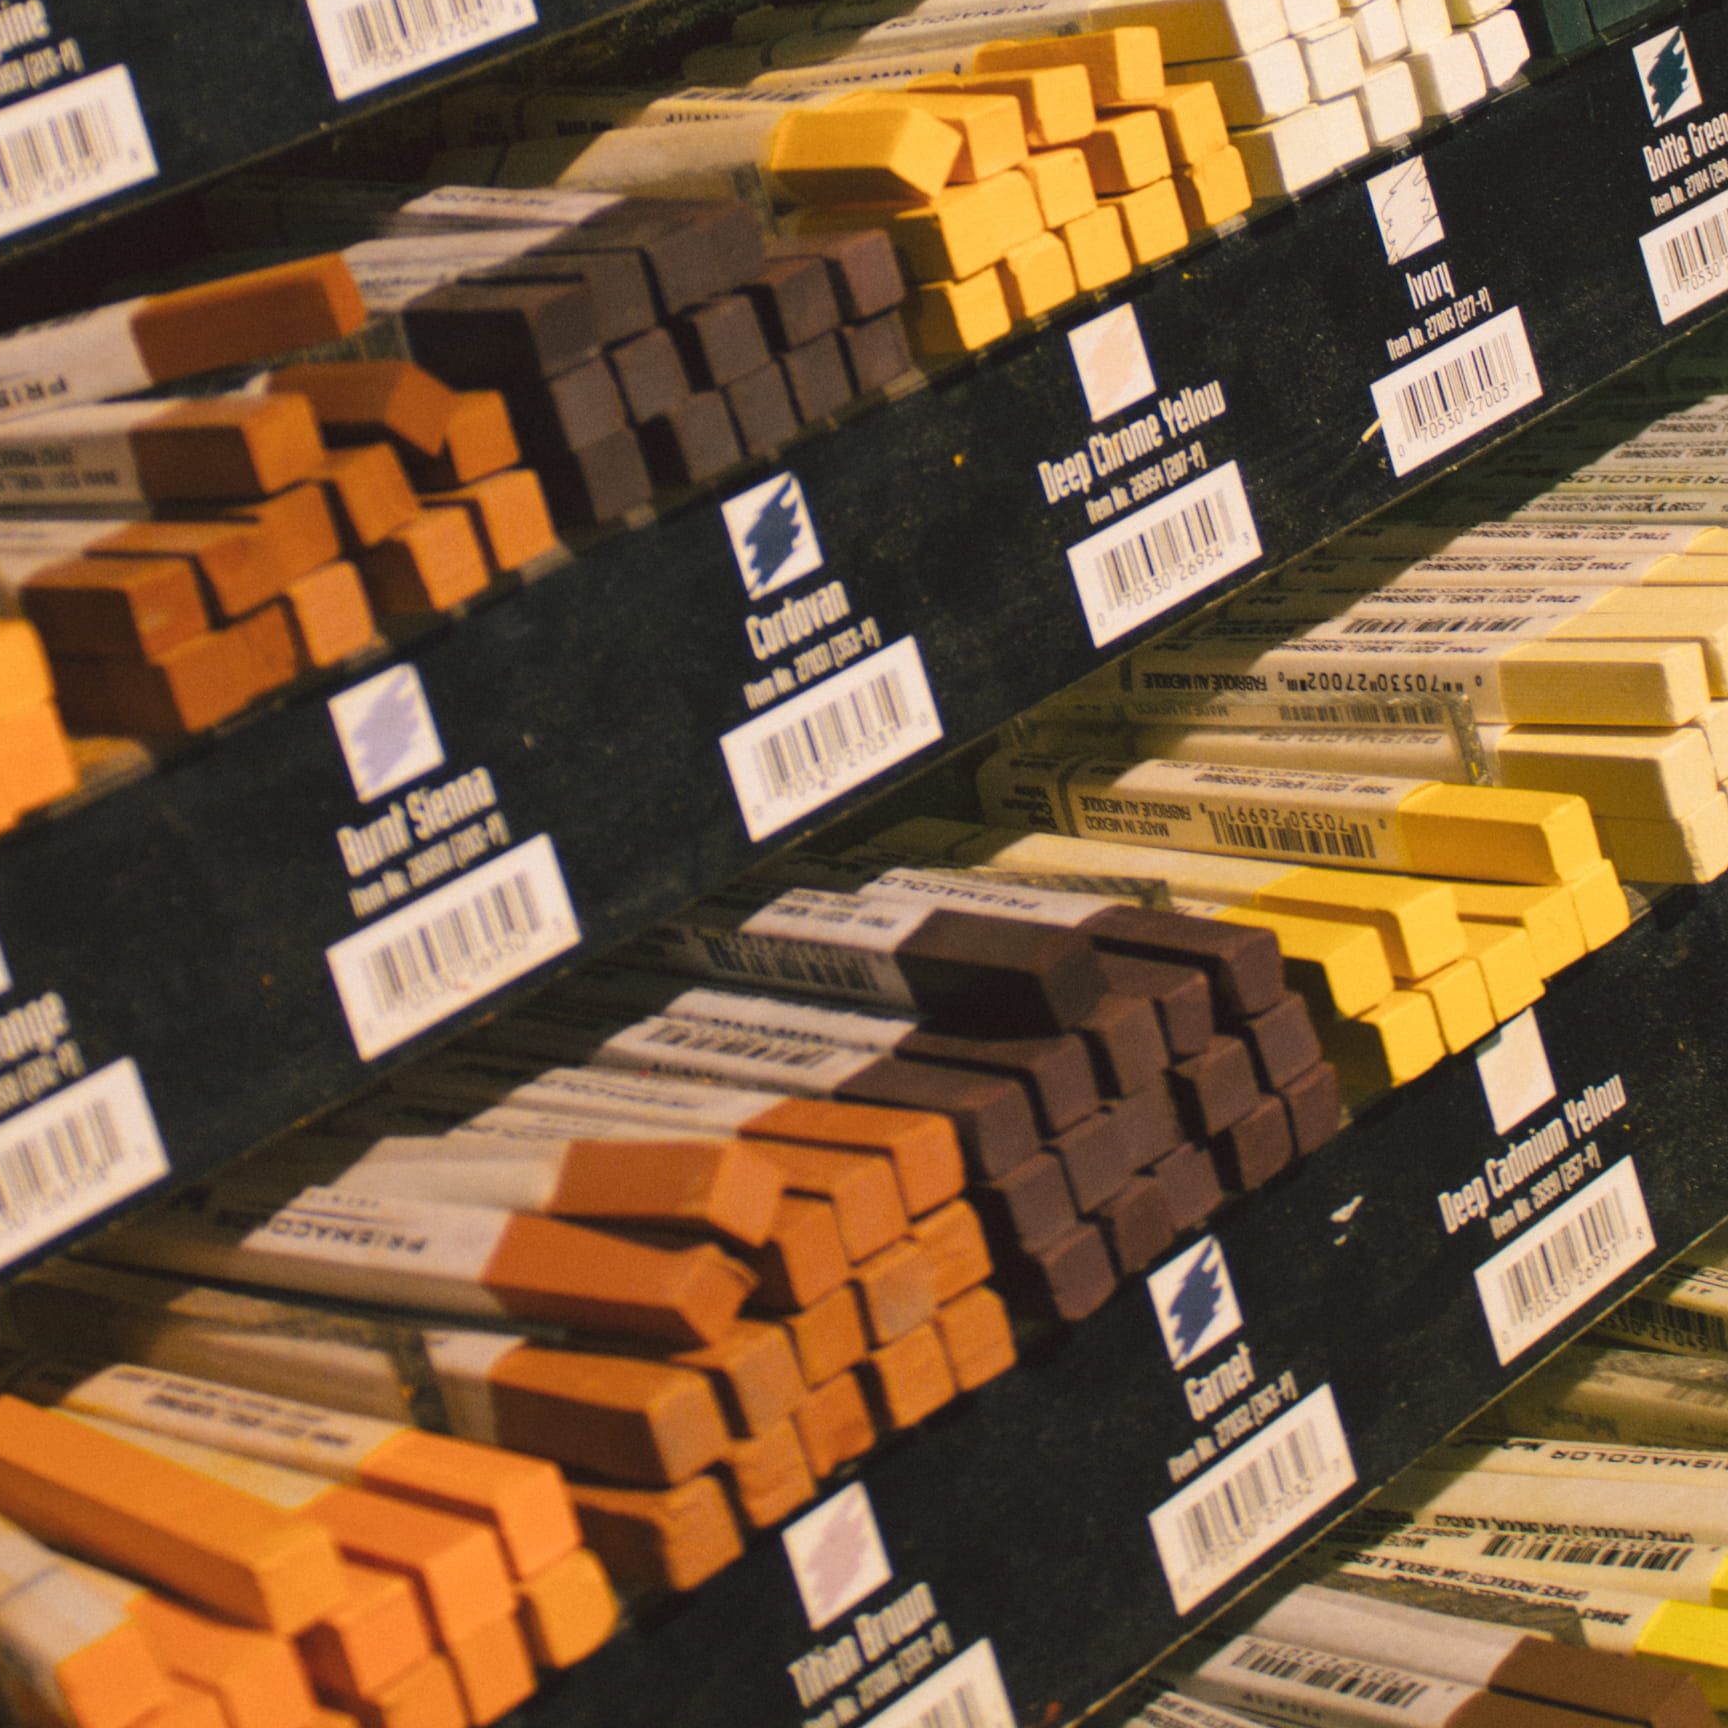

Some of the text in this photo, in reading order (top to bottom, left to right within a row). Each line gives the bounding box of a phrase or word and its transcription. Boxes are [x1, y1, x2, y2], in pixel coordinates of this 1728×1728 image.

[1643, 134, 1690, 181] Bottle
[1406, 262, 1455, 309] Ivory
[1386, 335, 1411, 360] Item
[1409, 327, 1427, 348] No.
[1425, 307, 1456, 340] 27003
[1038, 381, 1226, 503] Deep Chrome Yellow
[1086, 496, 1113, 523] Item
[746, 581, 850, 660] Cordovan
[1307, 673, 1440, 693] 70530 27002
[337, 768, 496, 876] Burnt Sienna
[1225, 804, 1348, 833] 70530 26991
[1438, 1075, 1626, 1233] Deep Cadmium Yellow
[1184, 1343, 1254, 1421] Garnet
